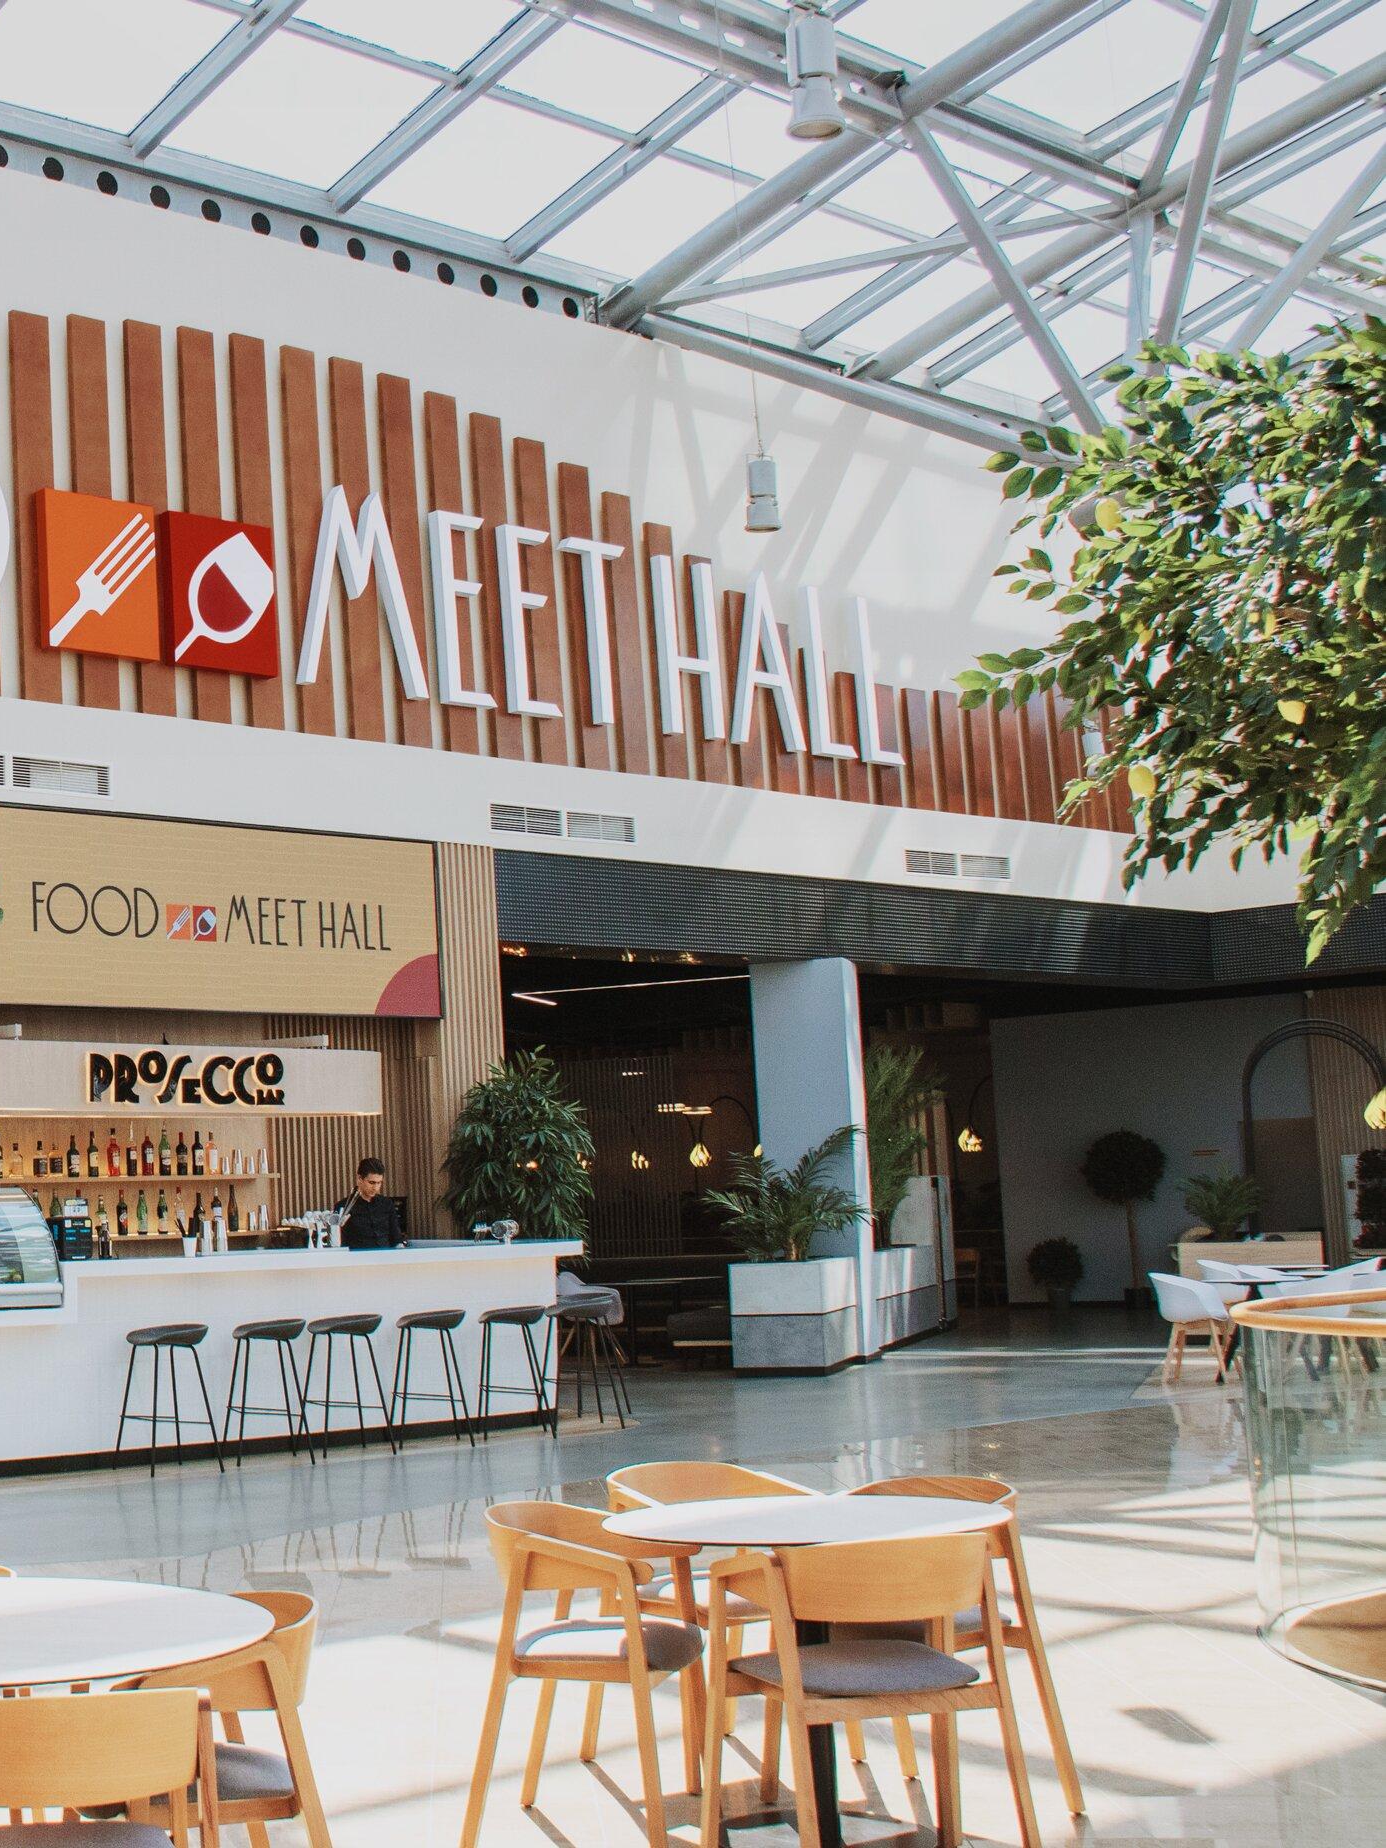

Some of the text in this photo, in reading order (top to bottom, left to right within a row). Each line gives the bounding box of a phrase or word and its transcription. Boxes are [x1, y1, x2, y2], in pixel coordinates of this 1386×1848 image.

[296, 484, 625, 727] MEET
[649, 554, 906, 766] HALL
[32, 881, 392, 951] FOOD MEET HALL
[88, 1050, 285, 1105] PROSECCO BAR
